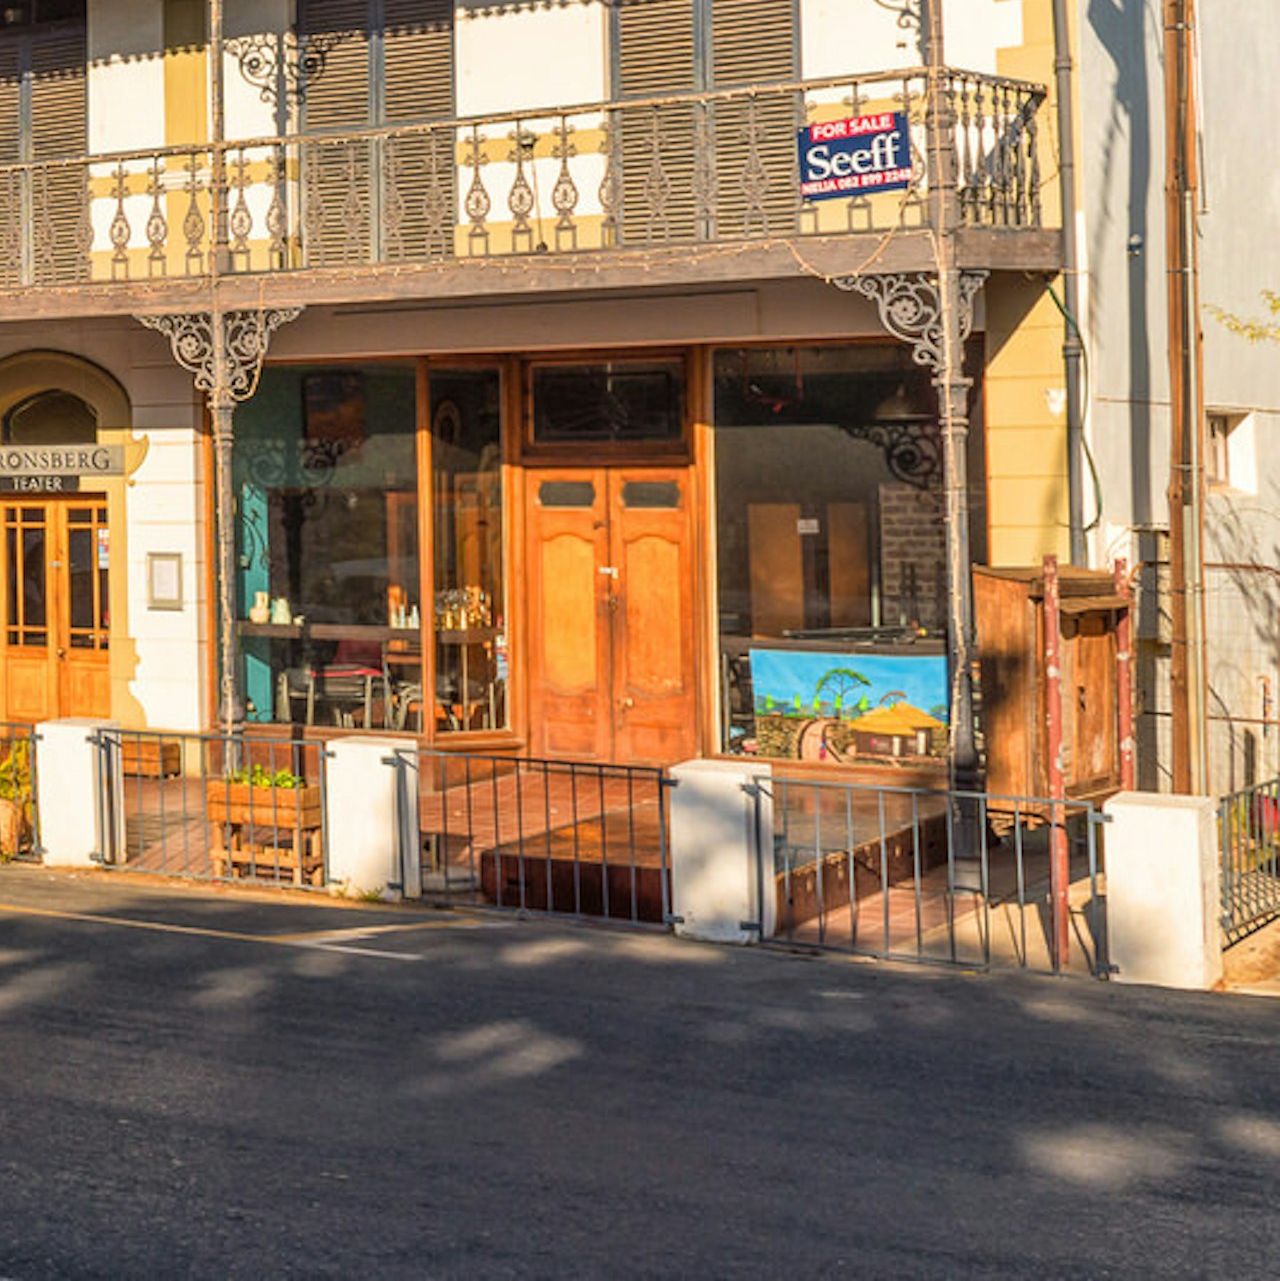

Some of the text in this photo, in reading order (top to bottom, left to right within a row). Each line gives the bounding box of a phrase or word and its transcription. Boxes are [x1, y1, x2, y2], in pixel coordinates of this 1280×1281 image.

[813, 115, 892, 140] FOR SALE
[806, 132, 900, 180] Seeff
[13, 476, 63, 490] TEATER
